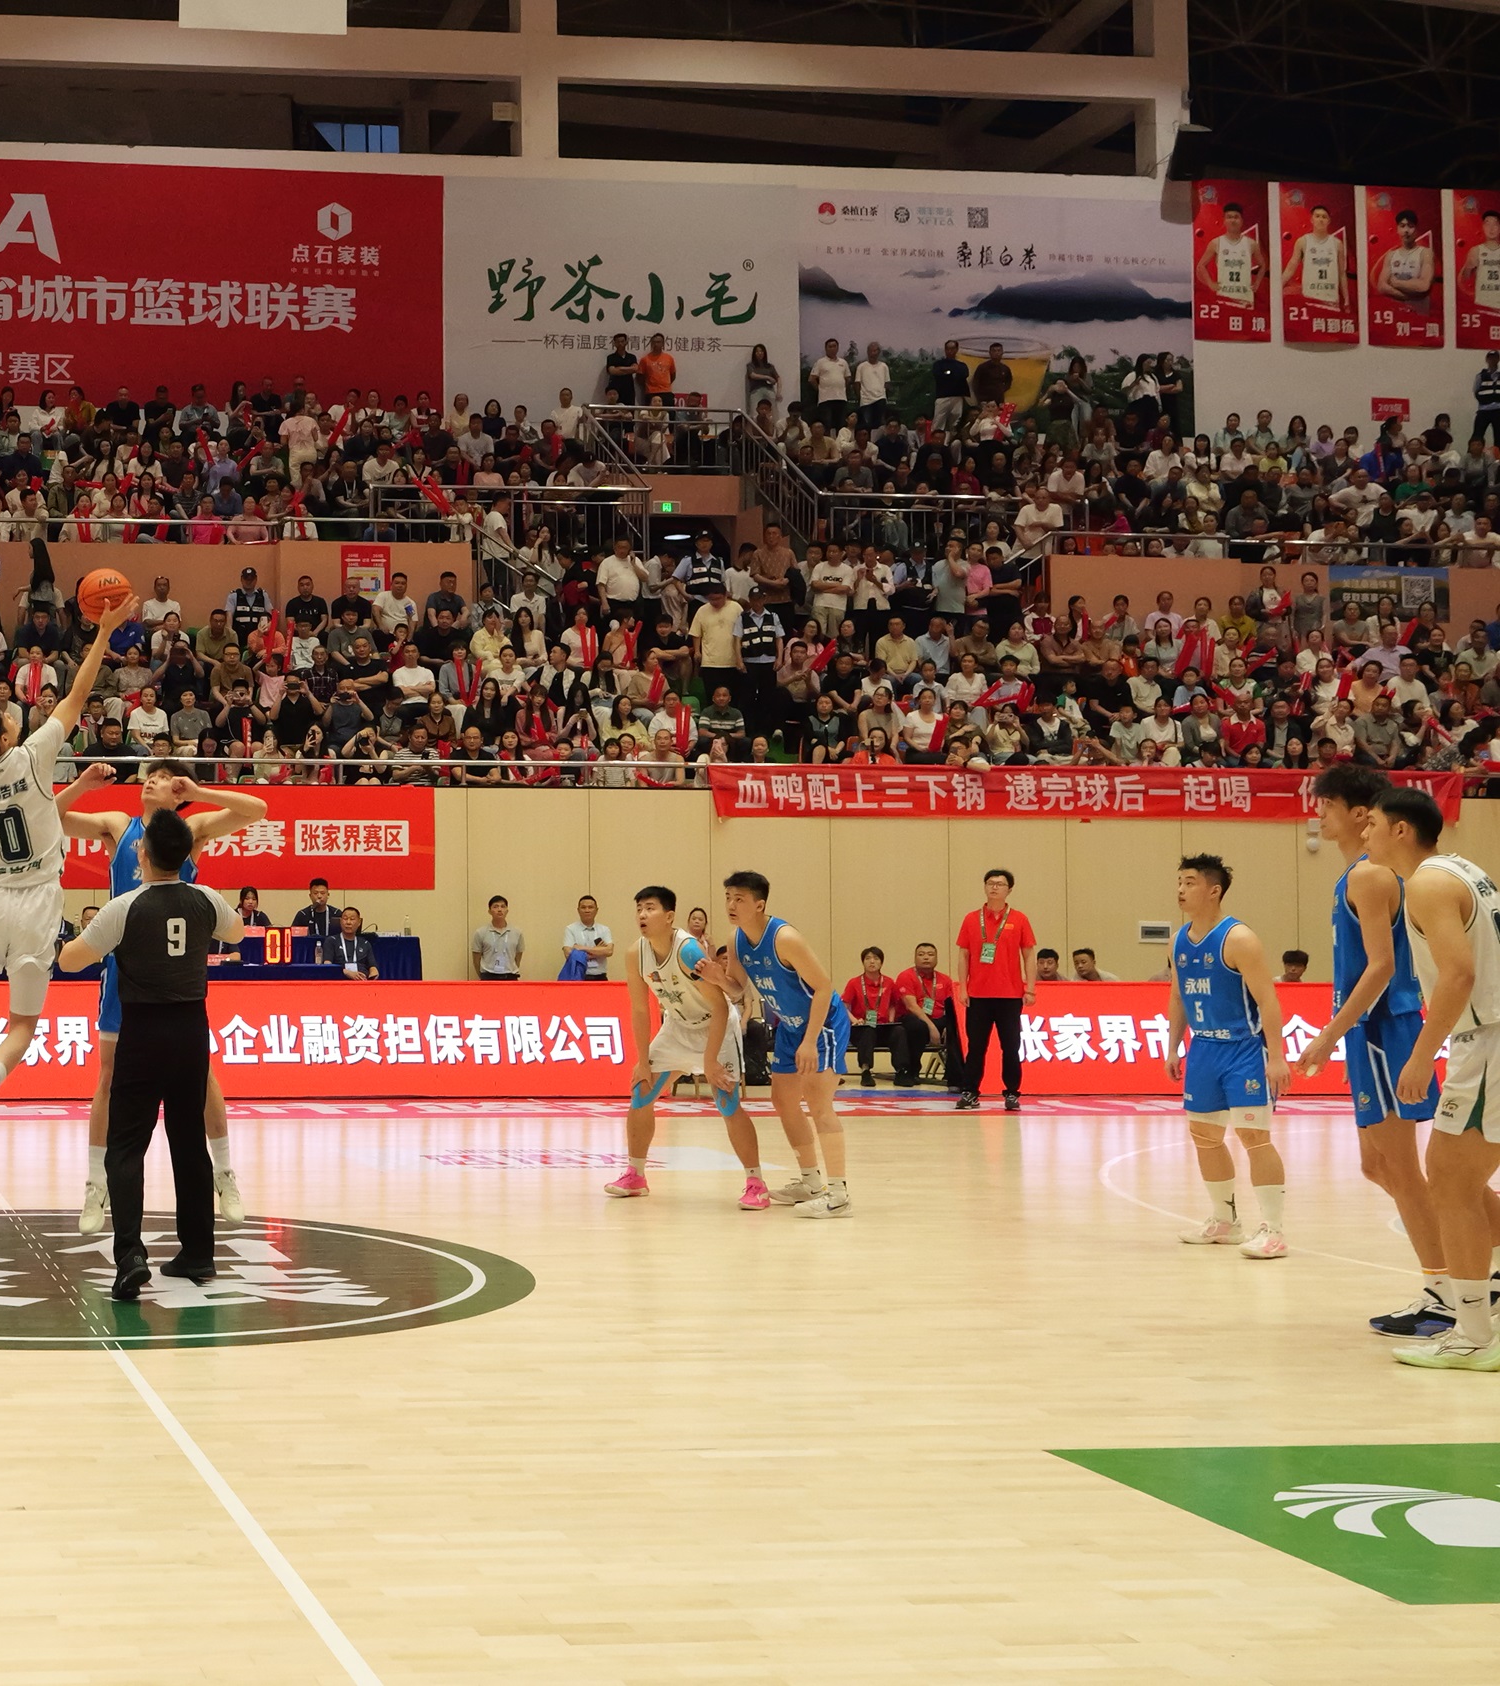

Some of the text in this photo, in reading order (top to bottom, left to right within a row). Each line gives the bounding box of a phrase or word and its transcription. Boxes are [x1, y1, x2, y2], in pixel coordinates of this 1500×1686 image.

[291, 244, 380, 266] 点石家装
[956, 241, 1037, 270] 桑植白茶
[488, 254, 758, 325] 野茶小毛
[1200, 304, 1220, 319] 22
[1289, 307, 1309, 321] 21
[1373, 310, 1394, 325] 19
[1461, 313, 1481, 328] 35
[734, 773, 986, 812] 血鸭配上三下锅
[300, 824, 406, 854] 张家界赛区
[167, 918, 187, 957] 9
[1185, 978, 1211, 995] 永州
[1194, 1001, 1204, 1022] 5
